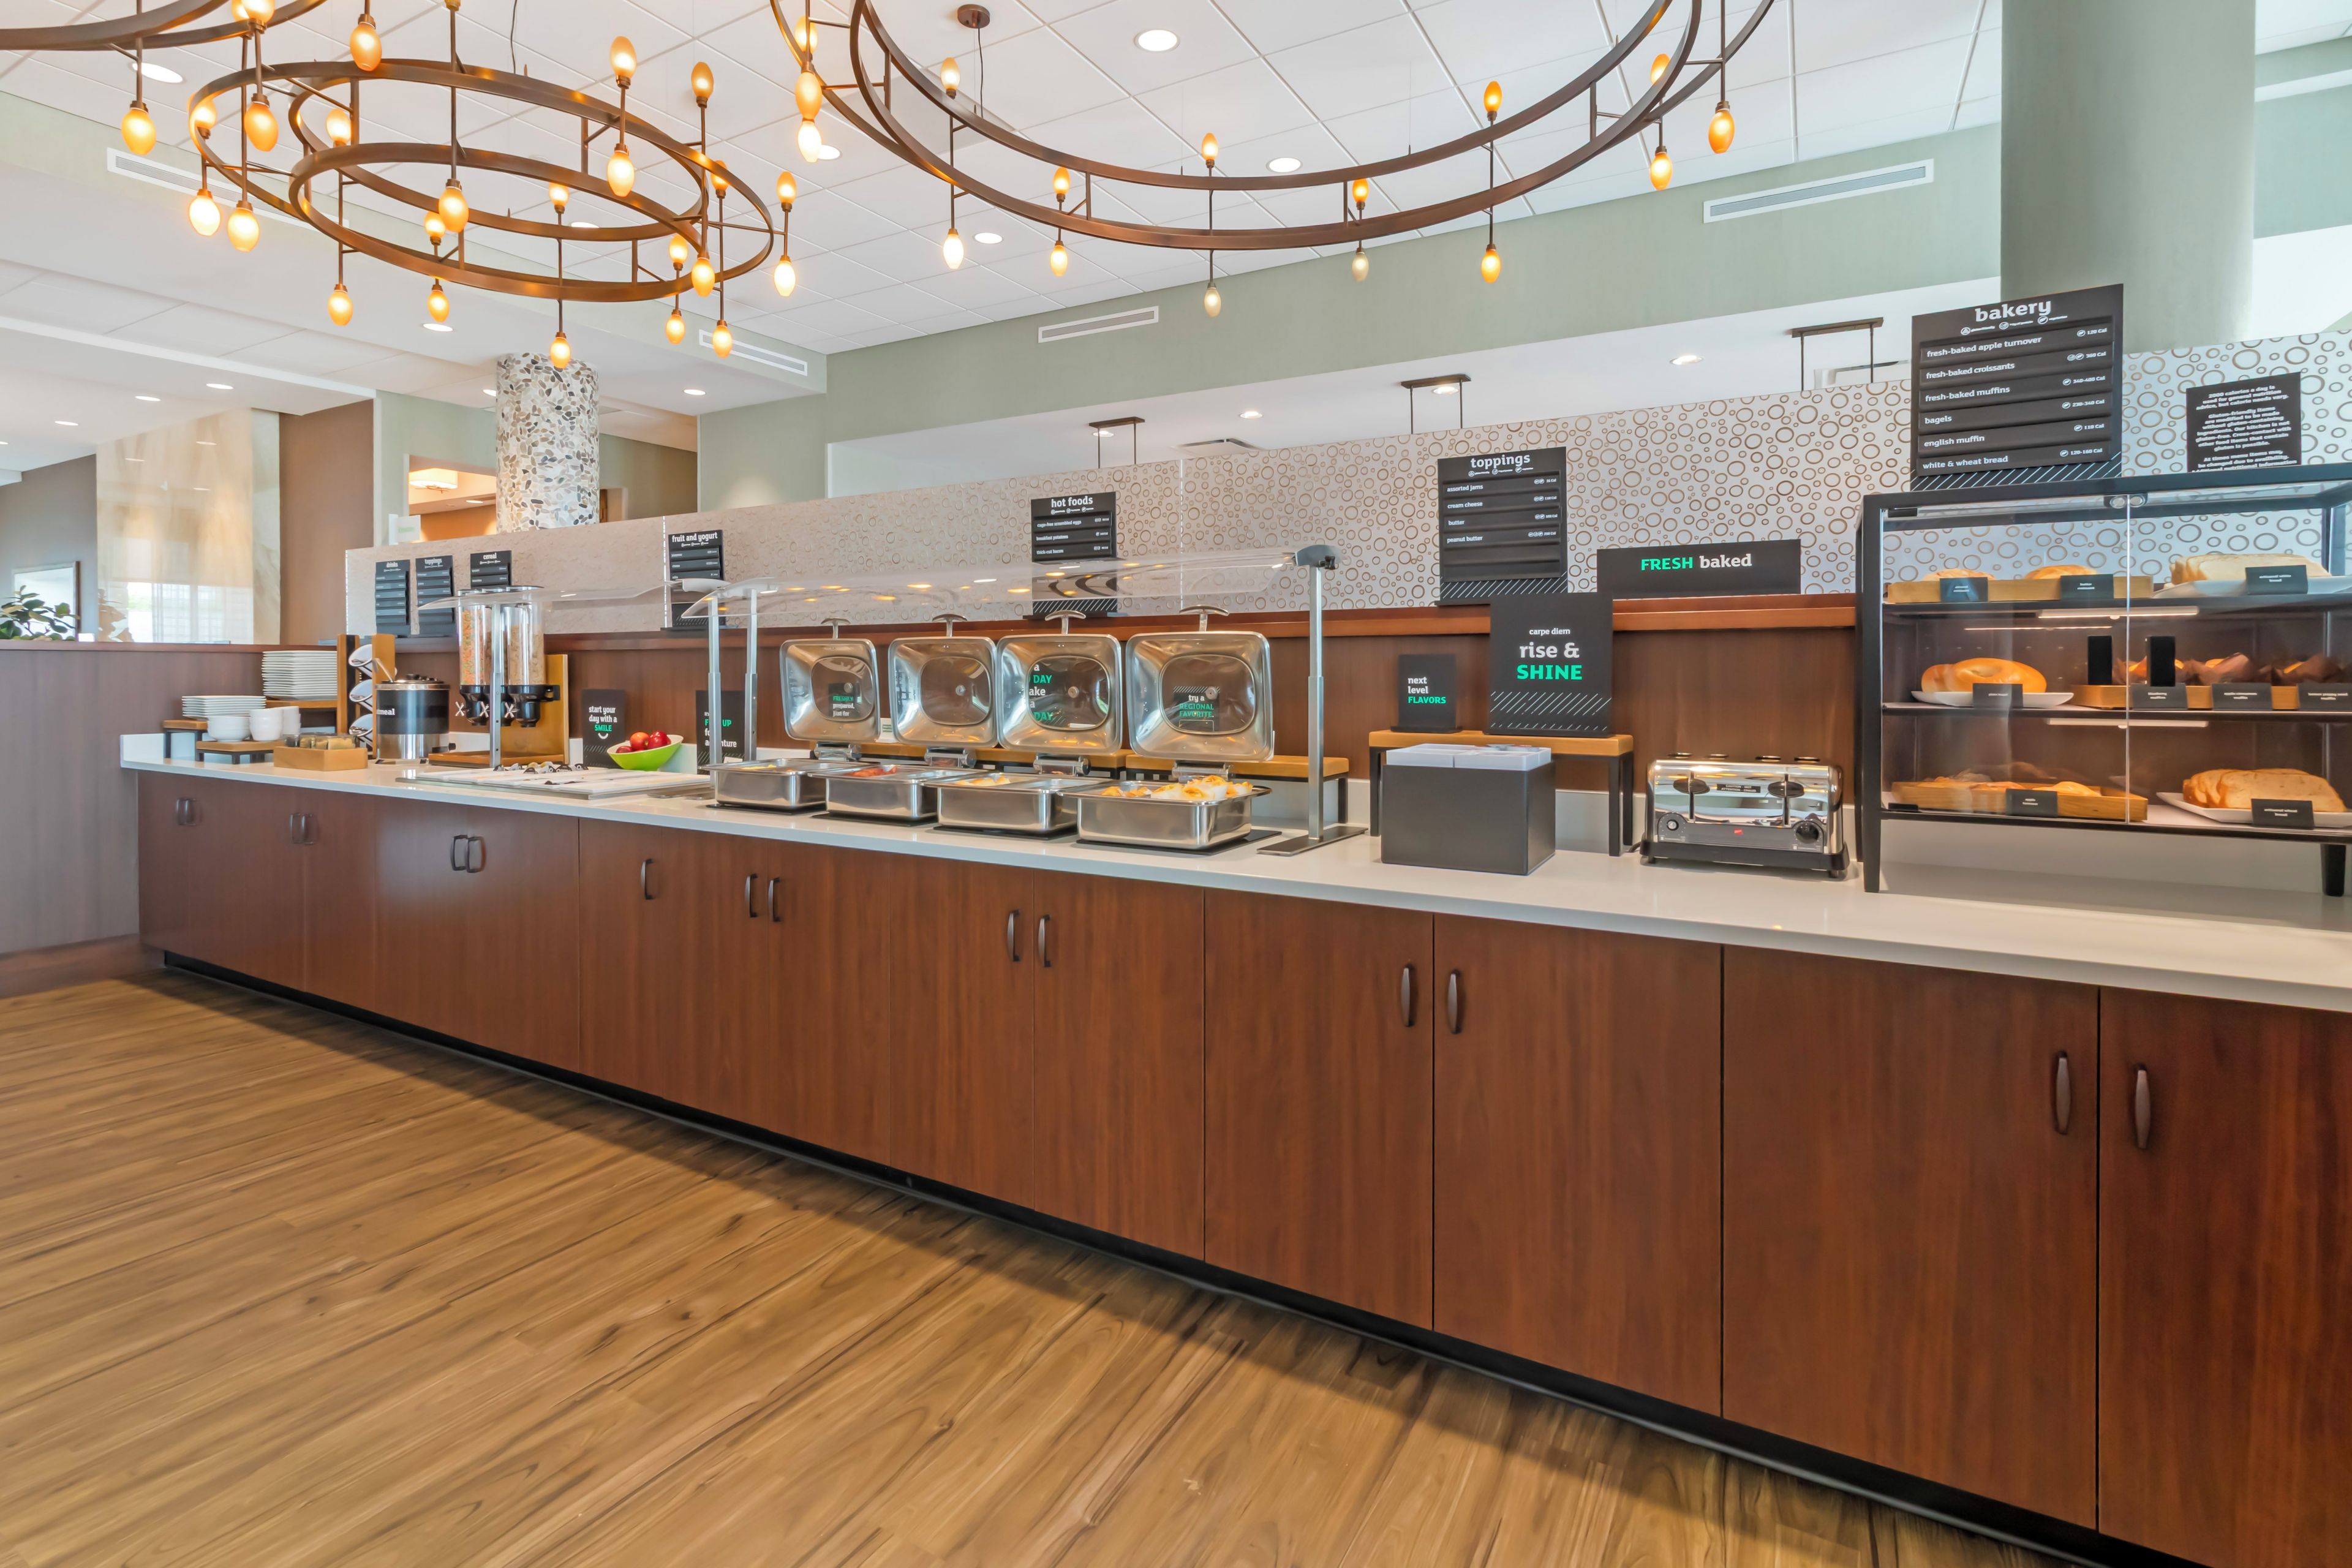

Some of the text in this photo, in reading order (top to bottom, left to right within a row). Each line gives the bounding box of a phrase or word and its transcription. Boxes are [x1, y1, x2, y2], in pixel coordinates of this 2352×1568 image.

[1975, 301, 2051, 322] bakery
[1927, 337, 2042, 357] fresh-baked apple turnover
[1926, 363, 2015, 379] fresh-baked croissants
[1925, 386, 2010, 401] fresh-baked muffins
[1924, 415, 1952, 425] bagels
[1924, 434, 1985, 448] english muffin
[1471, 454, 1531, 469] toppings
[1923, 461, 1945, 469] white
[1956, 458, 1981, 467] wheat
[1984, 455, 2008, 464] bread
[1051, 496, 1093, 508] hot foods
[686, 533, 697, 541] and
[698, 532, 718, 542] yogurt
[1641, 554, 1752, 571] FRESH baked
[1520, 642, 1580, 658] rise &
[1033, 675, 1052, 684] DAY
[1517, 665, 1583, 680] SHINE
[589, 714, 600, 724] day
